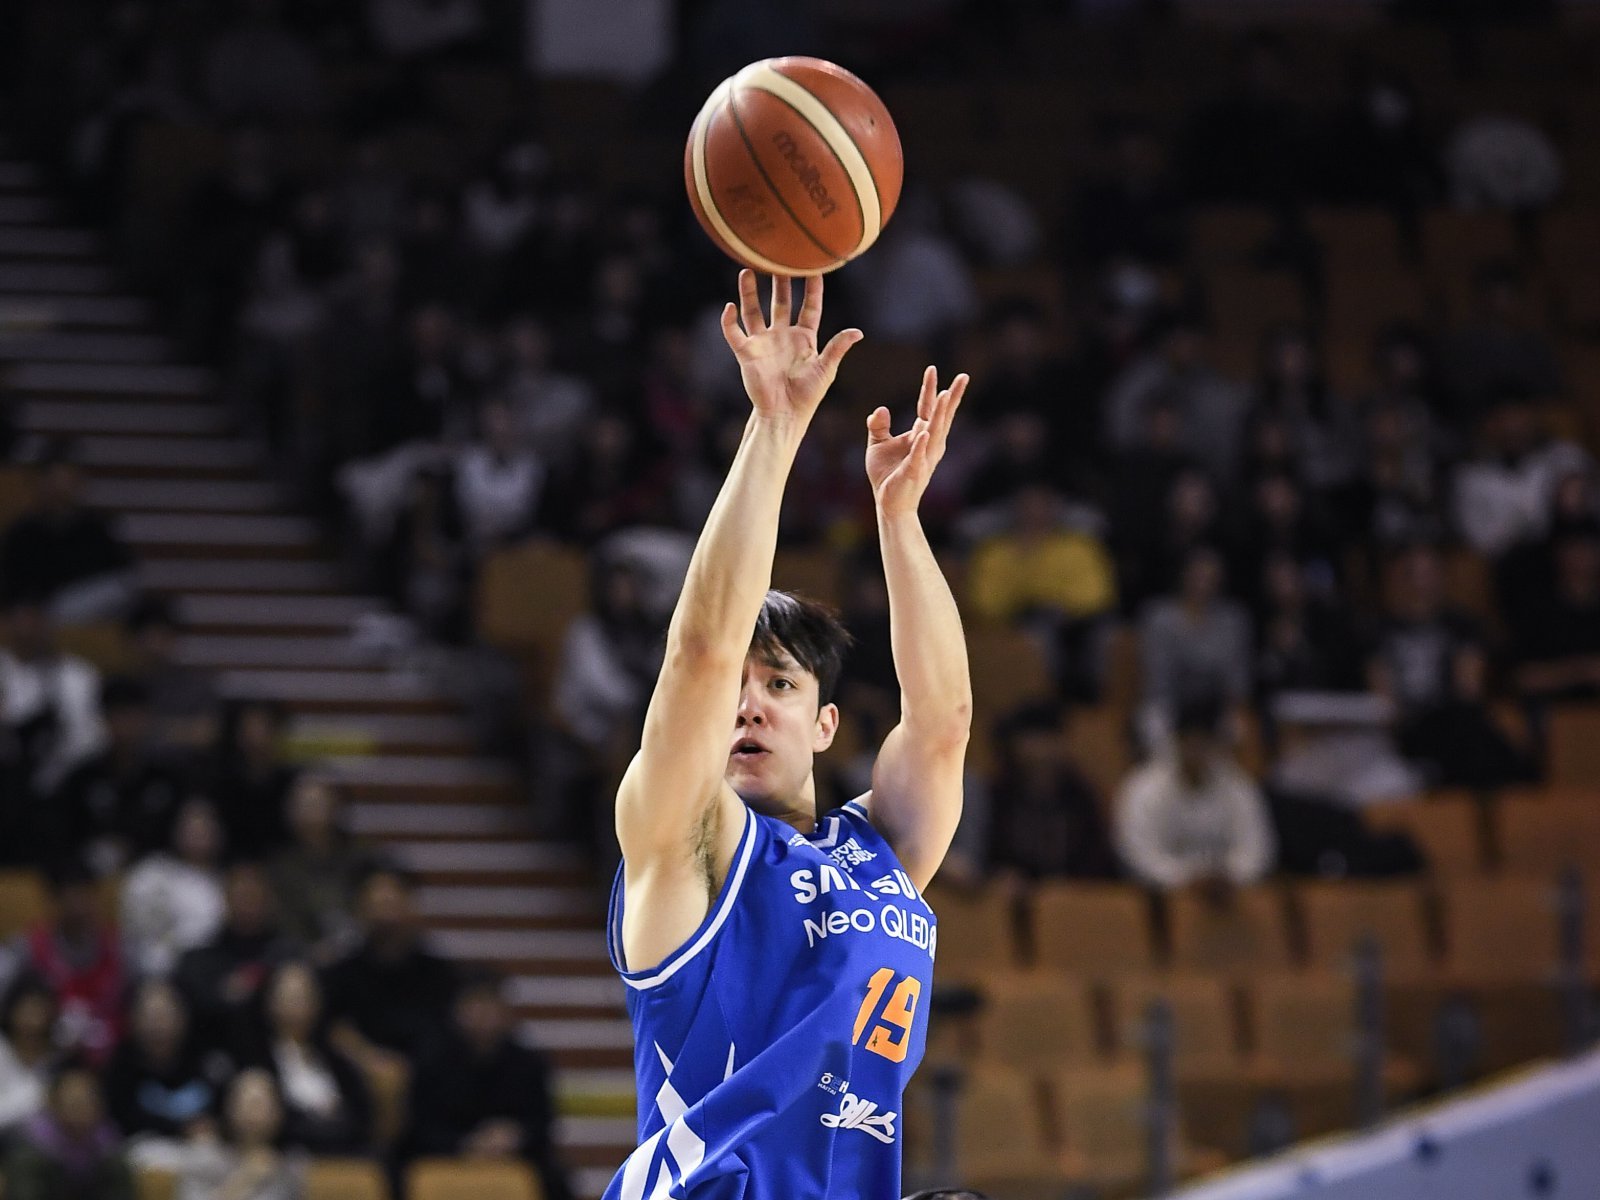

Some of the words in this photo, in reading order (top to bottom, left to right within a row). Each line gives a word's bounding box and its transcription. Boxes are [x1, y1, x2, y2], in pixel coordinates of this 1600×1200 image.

[803, 908, 875, 948] Neo
[880, 904, 928, 950] QLED
[852, 967, 921, 1063] 19
